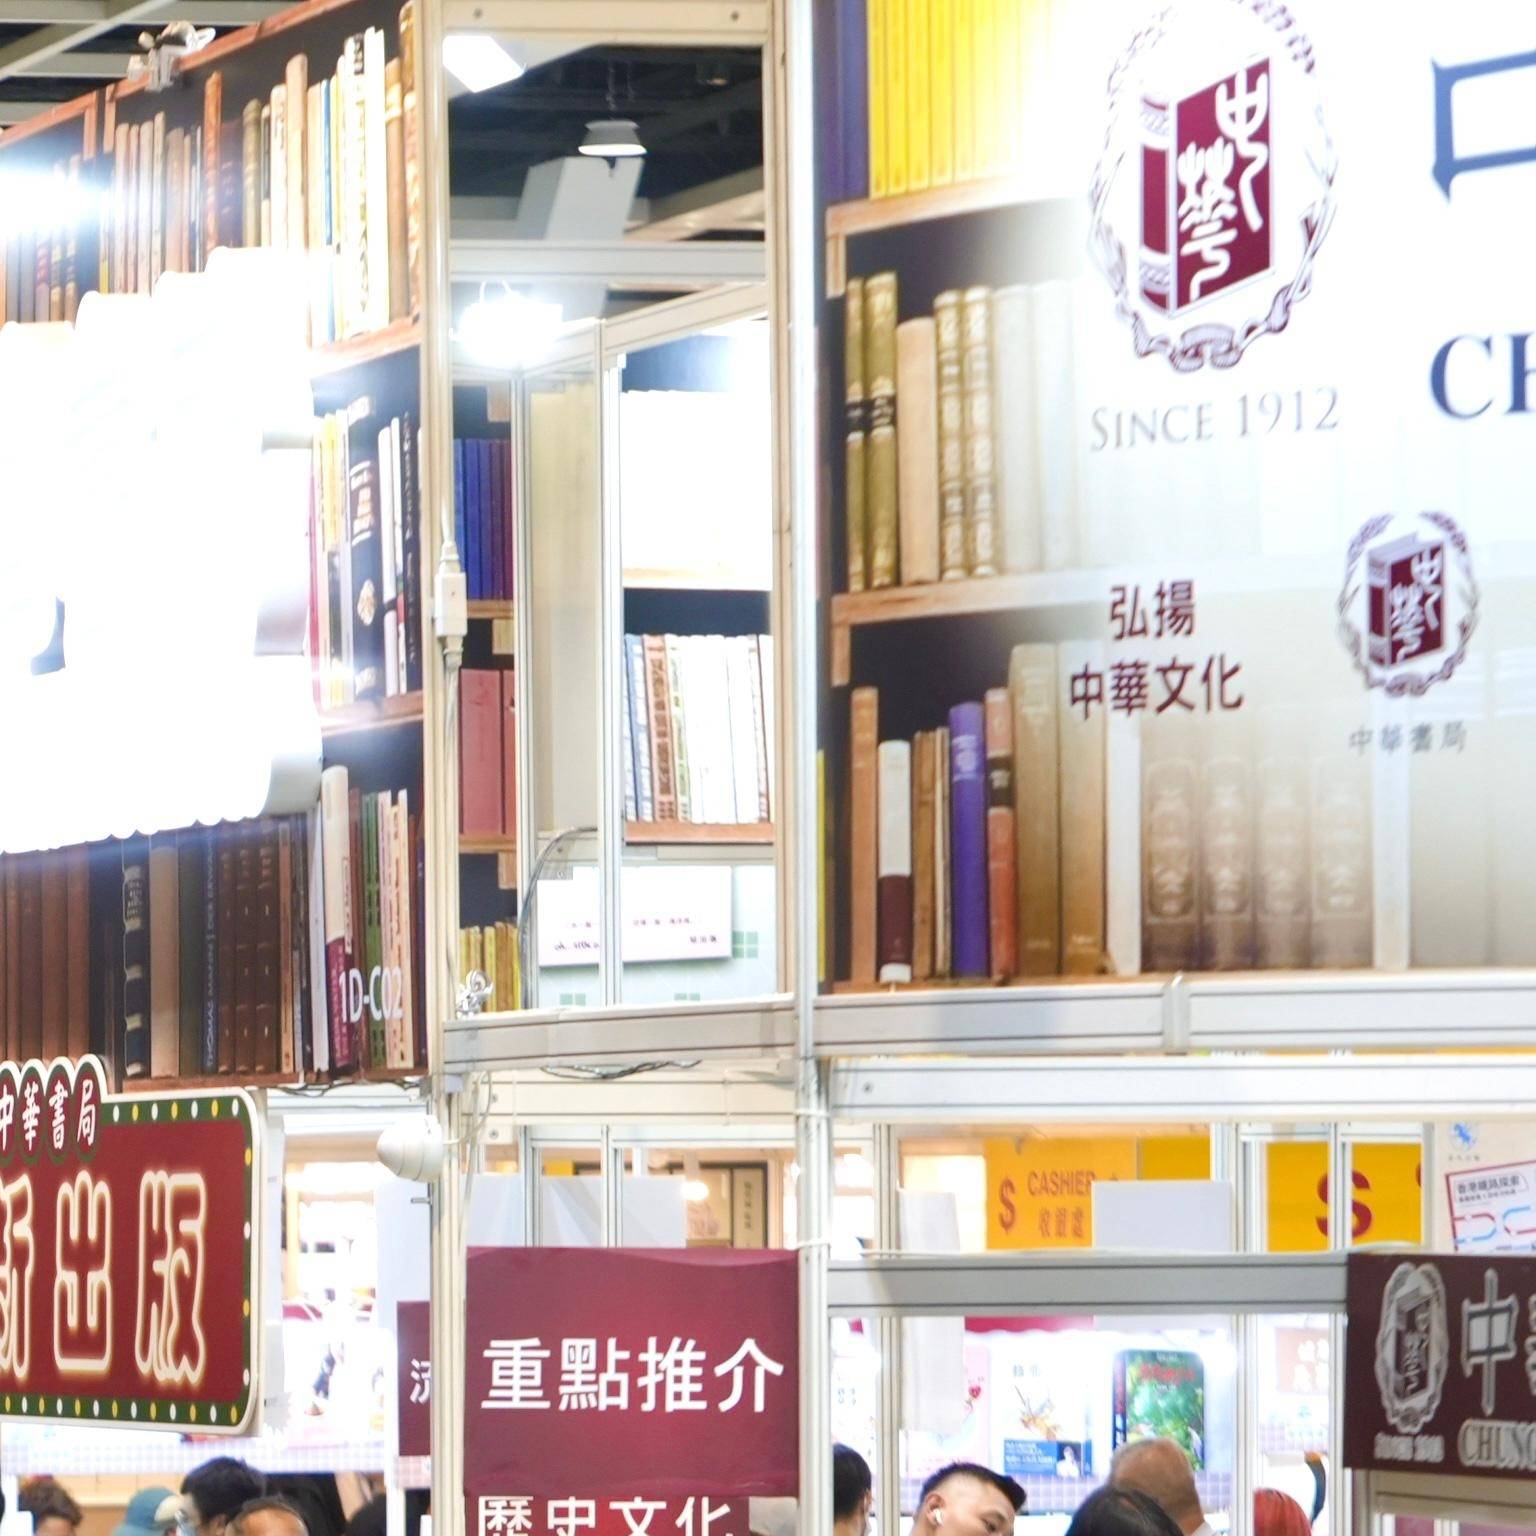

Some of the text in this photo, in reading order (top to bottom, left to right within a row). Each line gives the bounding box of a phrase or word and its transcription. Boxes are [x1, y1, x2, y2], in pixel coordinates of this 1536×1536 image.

[1091, 387, 1341, 453] SINCE 1912
[1109, 580, 1196, 640] 弘揚
[1070, 654, 1245, 721] 中華文化
[338, 965, 404, 1023] 1D-C02
[480, 1336, 785, 1413] 重點推介
